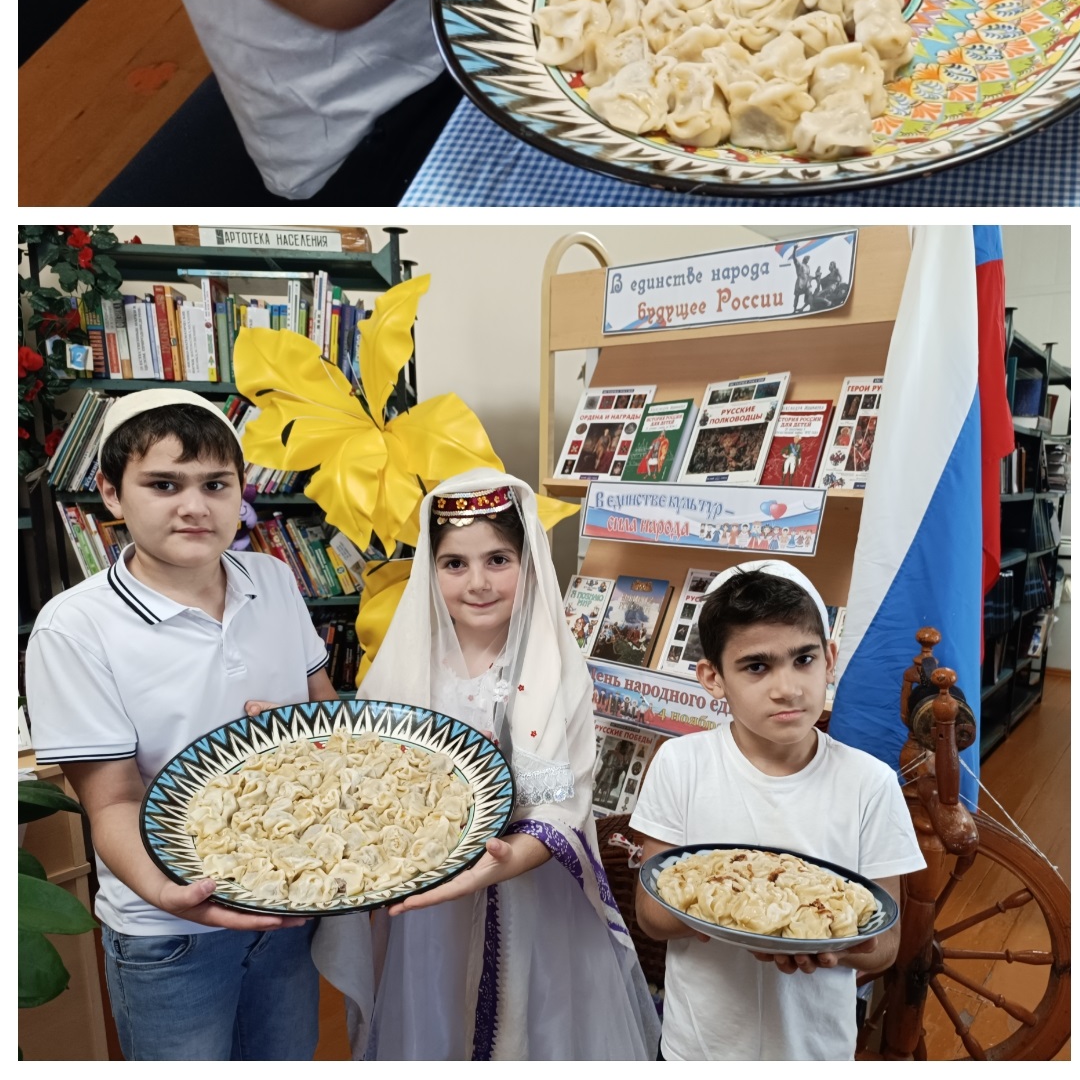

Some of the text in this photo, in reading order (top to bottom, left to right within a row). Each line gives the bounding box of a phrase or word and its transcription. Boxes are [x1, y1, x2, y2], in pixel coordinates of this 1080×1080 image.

[276, 233, 328, 247] НАСЕЛЕНИЯ
[610, 272, 622, 294] В
[630, 266, 702, 296] единстве
[711, 261, 770, 285] народа
[638, 287, 784, 325] будущее России
[75, 351, 83, 362] 2
[847, 385, 870, 393] ГЕРОИ
[721, 405, 756, 415] РУССКИЕ
[708, 413, 763, 425] ПОЛКОВОДЦЫ
[624, 678, 706, 709] народного
[657, 708, 666, 721] 4
[595, 724, 654, 745] РУССКИЕ ПОБЕДЫ
